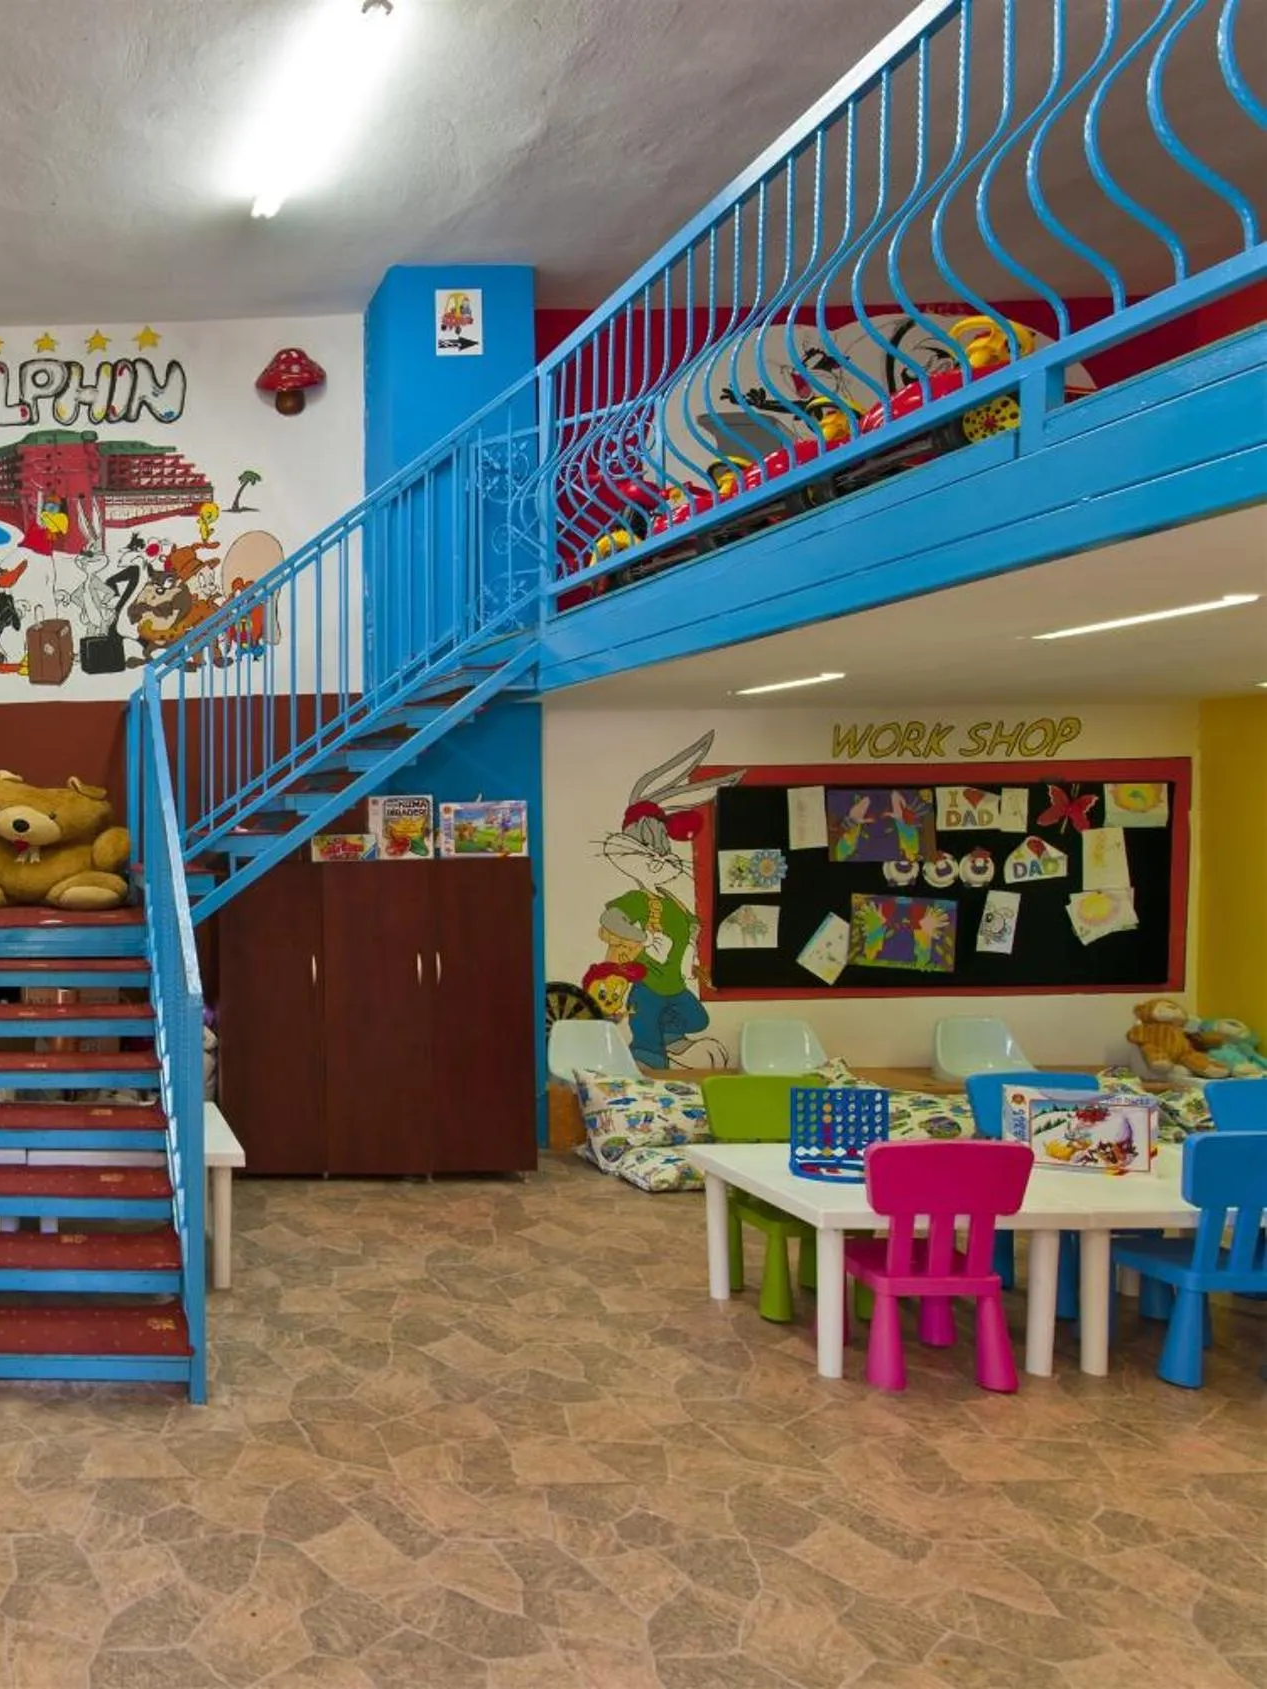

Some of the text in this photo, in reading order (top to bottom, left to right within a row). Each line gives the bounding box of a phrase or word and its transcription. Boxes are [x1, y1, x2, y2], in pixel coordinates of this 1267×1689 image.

[832, 717, 1081, 758] WORK SHOP
[945, 809, 994, 827] DAD
